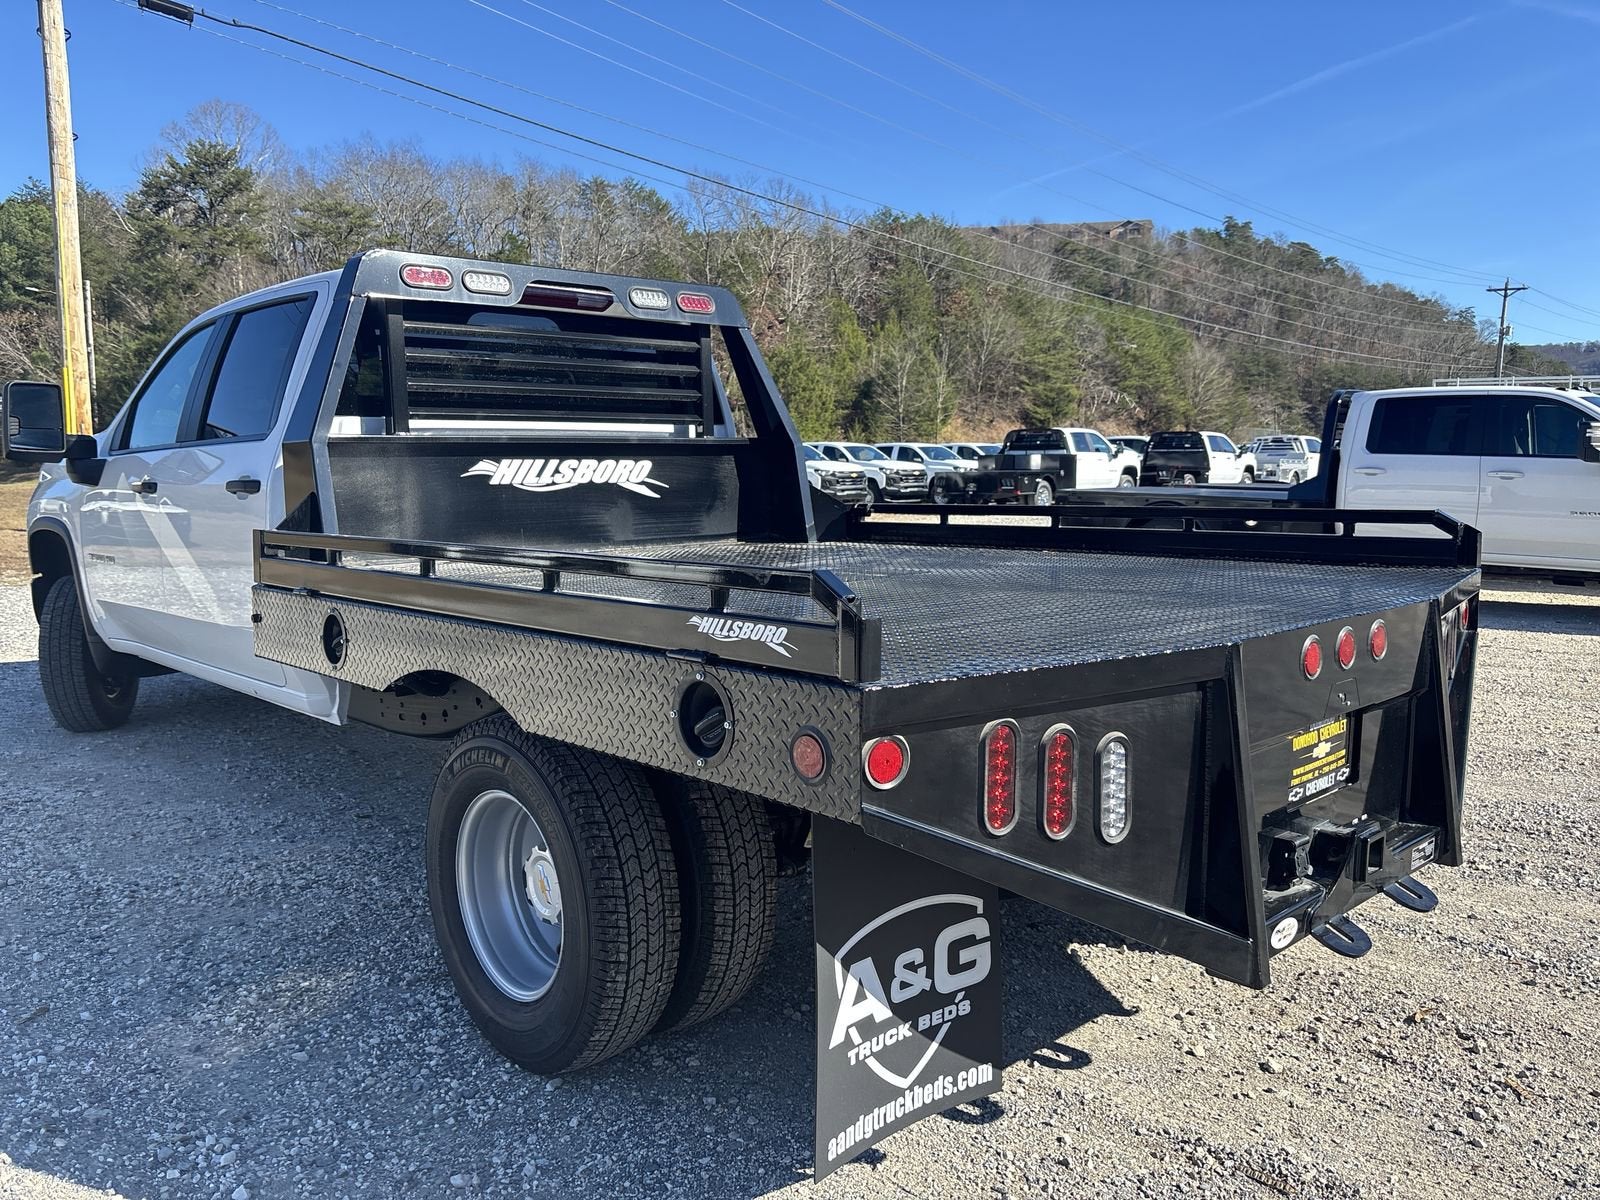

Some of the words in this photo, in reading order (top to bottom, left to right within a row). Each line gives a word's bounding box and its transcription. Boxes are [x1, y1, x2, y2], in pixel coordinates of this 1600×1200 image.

[489, 458, 654, 486] HILLSBORO
[697, 615, 789, 645] HILLSBORO
[1320, 719, 1347, 741] CHEVROLET
[452, 749, 506, 775] MICHELIN
[1305, 772, 1336, 797] CHEVROLET
[828, 916, 993, 1051] A&G
[847, 1021, 912, 1065] TRUCK
[827, 1062, 993, 1162] aandgtruckbeds.com
